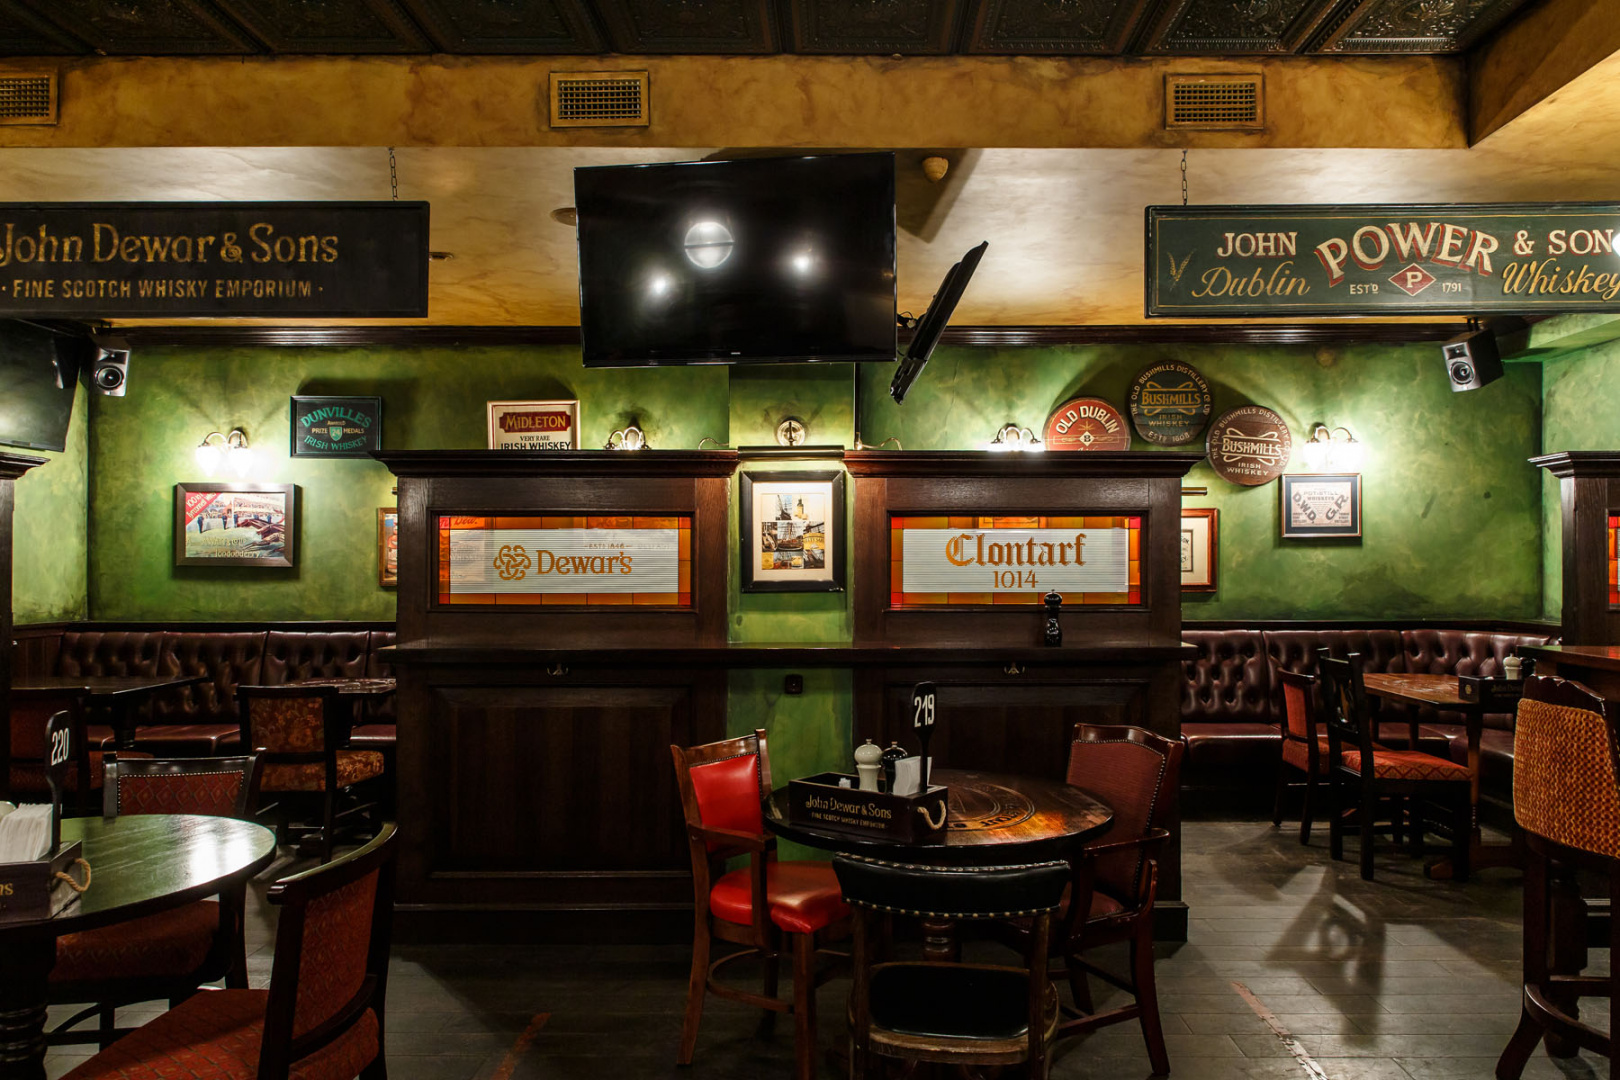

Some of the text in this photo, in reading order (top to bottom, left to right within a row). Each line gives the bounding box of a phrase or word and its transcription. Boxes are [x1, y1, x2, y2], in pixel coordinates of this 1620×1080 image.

[0, 223, 340, 267] John Dewar & Sons
[1217, 231, 1298, 258] JOHN
[1314, 222, 1499, 287] POWER
[1513, 230, 1534, 256] &
[12, 279, 312, 298] FINE SCOTCH WHISKY EMPORIUM
[1192, 258, 1620, 300] Dublin Whiskey
[1406, 273, 1423, 287] P
[1442, 283, 1462, 293] 1791
[1131, 385, 1140, 400] OLD
[1139, 364, 1175, 384] BUSHMILLS
[1176, 365, 1208, 393] DISTILLERY
[1141, 391, 1201, 405] BUSHMILLS
[505, 415, 566, 430] MIDLETON
[1055, 405, 1120, 434] OLD DUBLIN
[1219, 408, 1256, 428] BUSHMILLS
[1258, 409, 1290, 440] DISTILLERY
[304, 435, 367, 451] IRISH WHISKEY
[501, 441, 571, 450] IRISH WHISKEY
[1210, 429, 1220, 446] OLD
[1222, 437, 1281, 456] BUSHMILLS
[1211, 447, 1219, 459] THE
[1226, 467, 1269, 476] WHISKEY
[945, 533, 1088, 567] Clontarf
[536, 549, 633, 575] Dewar's
[993, 570, 1039, 588] 1014
[914, 693, 935, 728] 219
[51, 727, 70, 766] 220
[806, 795, 892, 819] John Dewar & Sons
